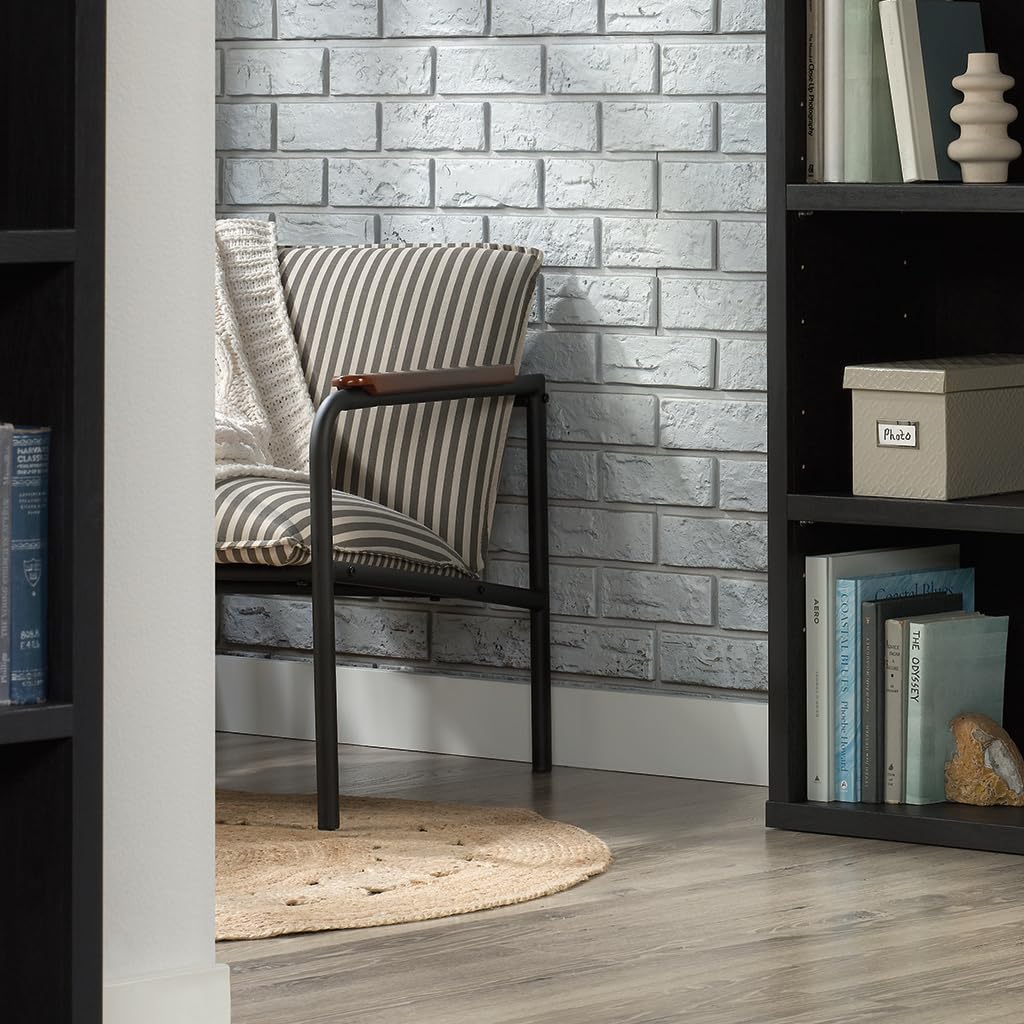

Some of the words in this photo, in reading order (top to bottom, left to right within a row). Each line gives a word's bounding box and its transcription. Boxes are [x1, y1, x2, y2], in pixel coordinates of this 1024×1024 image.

[807, 83, 815, 93] Up
[807, 94, 815, 136] Photography
[883, 427, 912, 440] Photo
[840, 593, 849, 651] COASTAL
[912, 631, 920, 650] THE
[840, 654, 849, 692] BLUES
[910, 657, 920, 702] ODYSSEY
[840, 701, 848, 733] Phoebe
[840, 736, 848, 771] Howard
